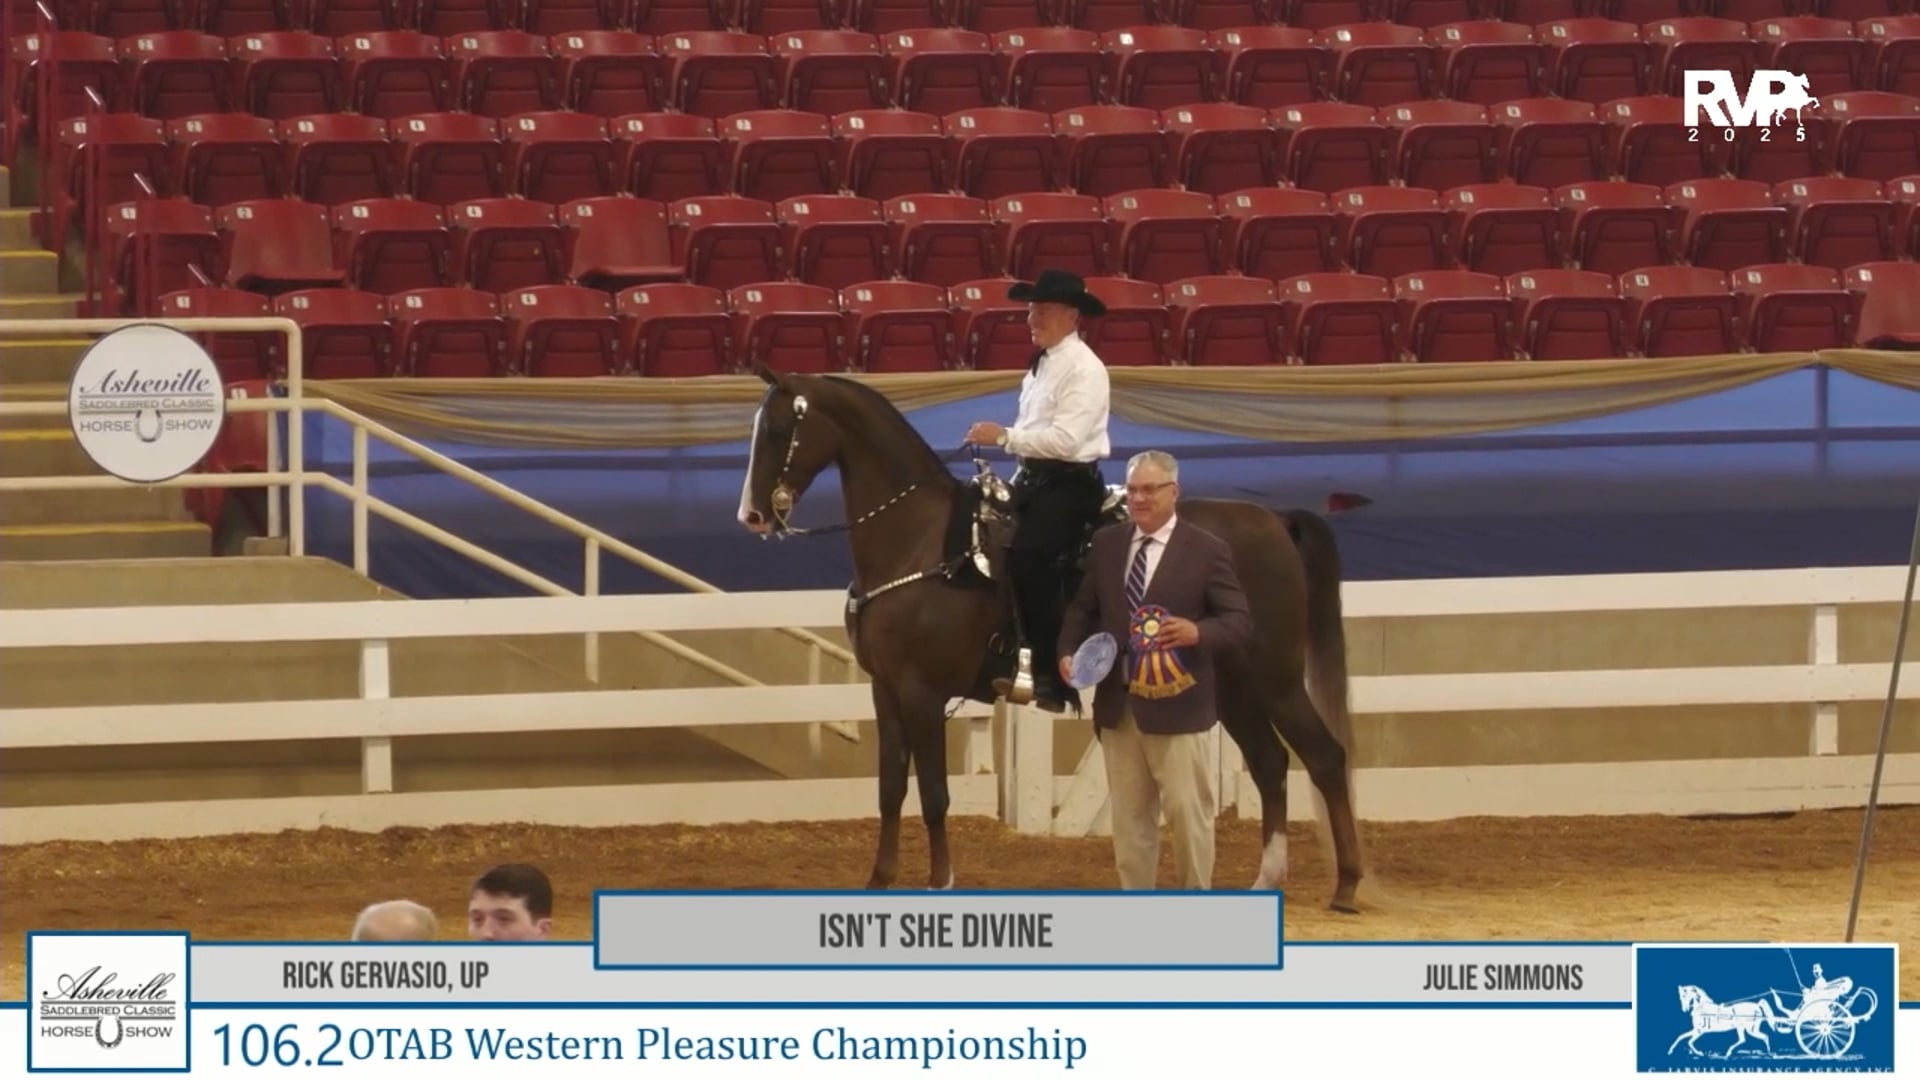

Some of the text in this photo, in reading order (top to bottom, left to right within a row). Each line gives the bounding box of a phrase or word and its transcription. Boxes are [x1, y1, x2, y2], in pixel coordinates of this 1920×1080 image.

[79, 368, 210, 394] Asheville
[79, 398, 214, 410] SADDLEBRED CLASSIC
[80, 418, 213, 433] HORSE SHOW
